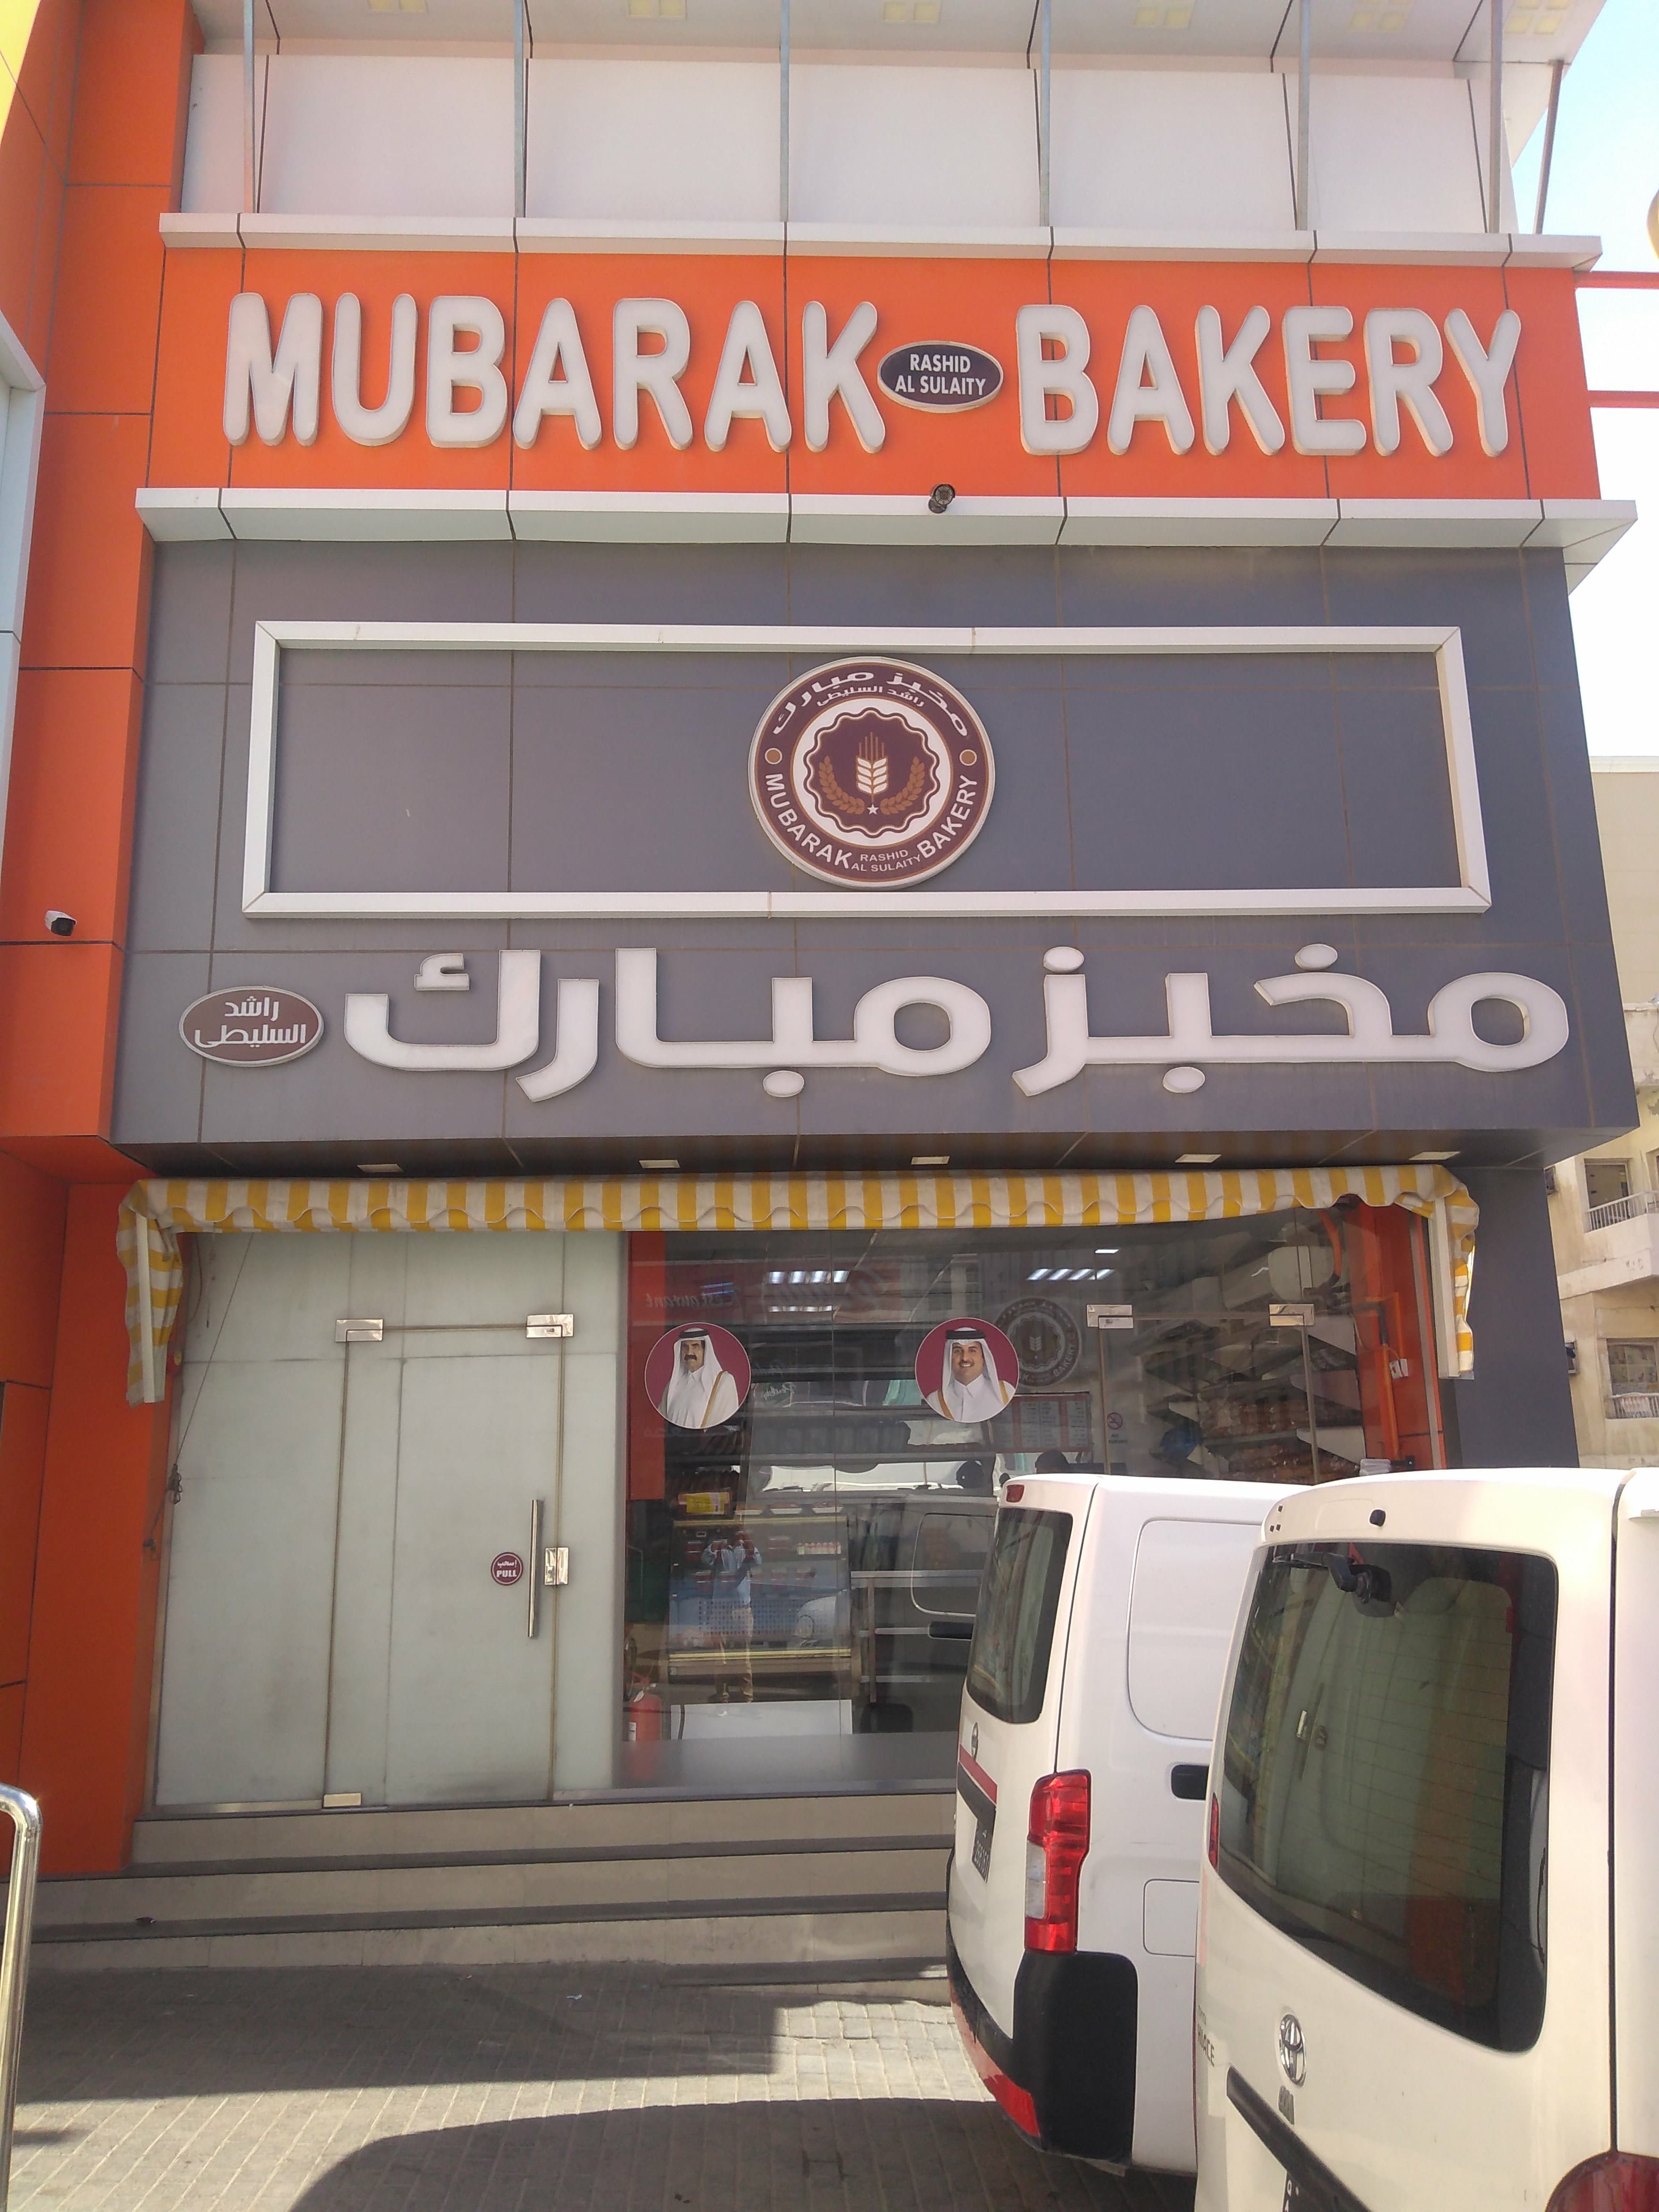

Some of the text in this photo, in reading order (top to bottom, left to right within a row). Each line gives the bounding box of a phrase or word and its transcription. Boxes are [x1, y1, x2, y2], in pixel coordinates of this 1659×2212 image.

[222, 291, 1522, 458] MUBARAK BAKERY
[910, 353, 971, 373] RASHID
[894, 375, 986, 396] AL SULAITY
[772, 671, 968, 738] مخبز مبارك
[887, 688, 925, 708] راشد
[765, 773, 978, 870] MUBARAK BAKERY
[851, 853, 921, 872] AL SULAITY
[860, 849, 909, 862] RASHID
[224, 995, 280, 1022] راشد
[343, 942, 1570, 1103] مخبز مبارك
[496, 1569, 517, 1578] PULL
[1197, 2022, 1215, 2068] HIACE
